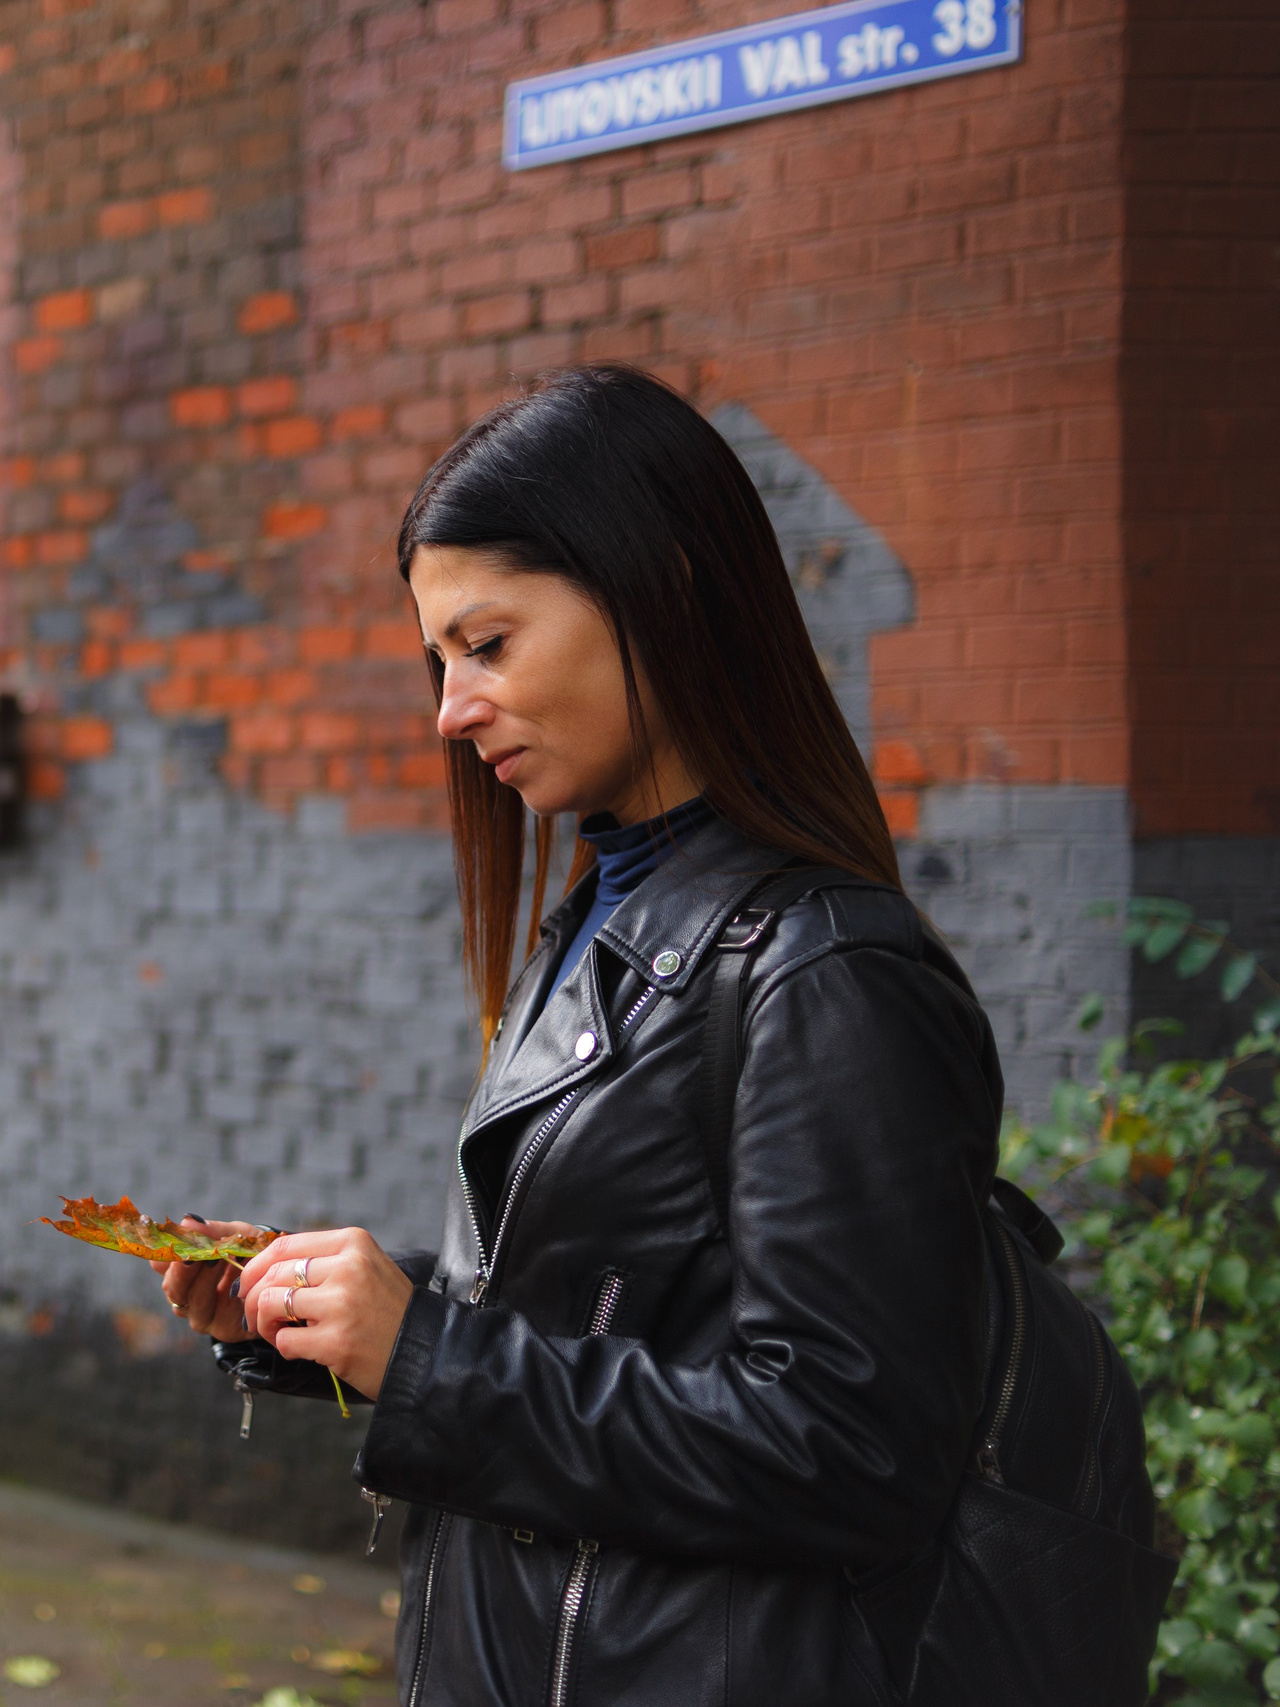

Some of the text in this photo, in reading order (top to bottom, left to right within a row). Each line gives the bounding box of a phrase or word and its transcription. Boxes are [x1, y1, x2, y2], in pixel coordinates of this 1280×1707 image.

[522, 0, 997, 147] LITOVSKII VAL str. 38
